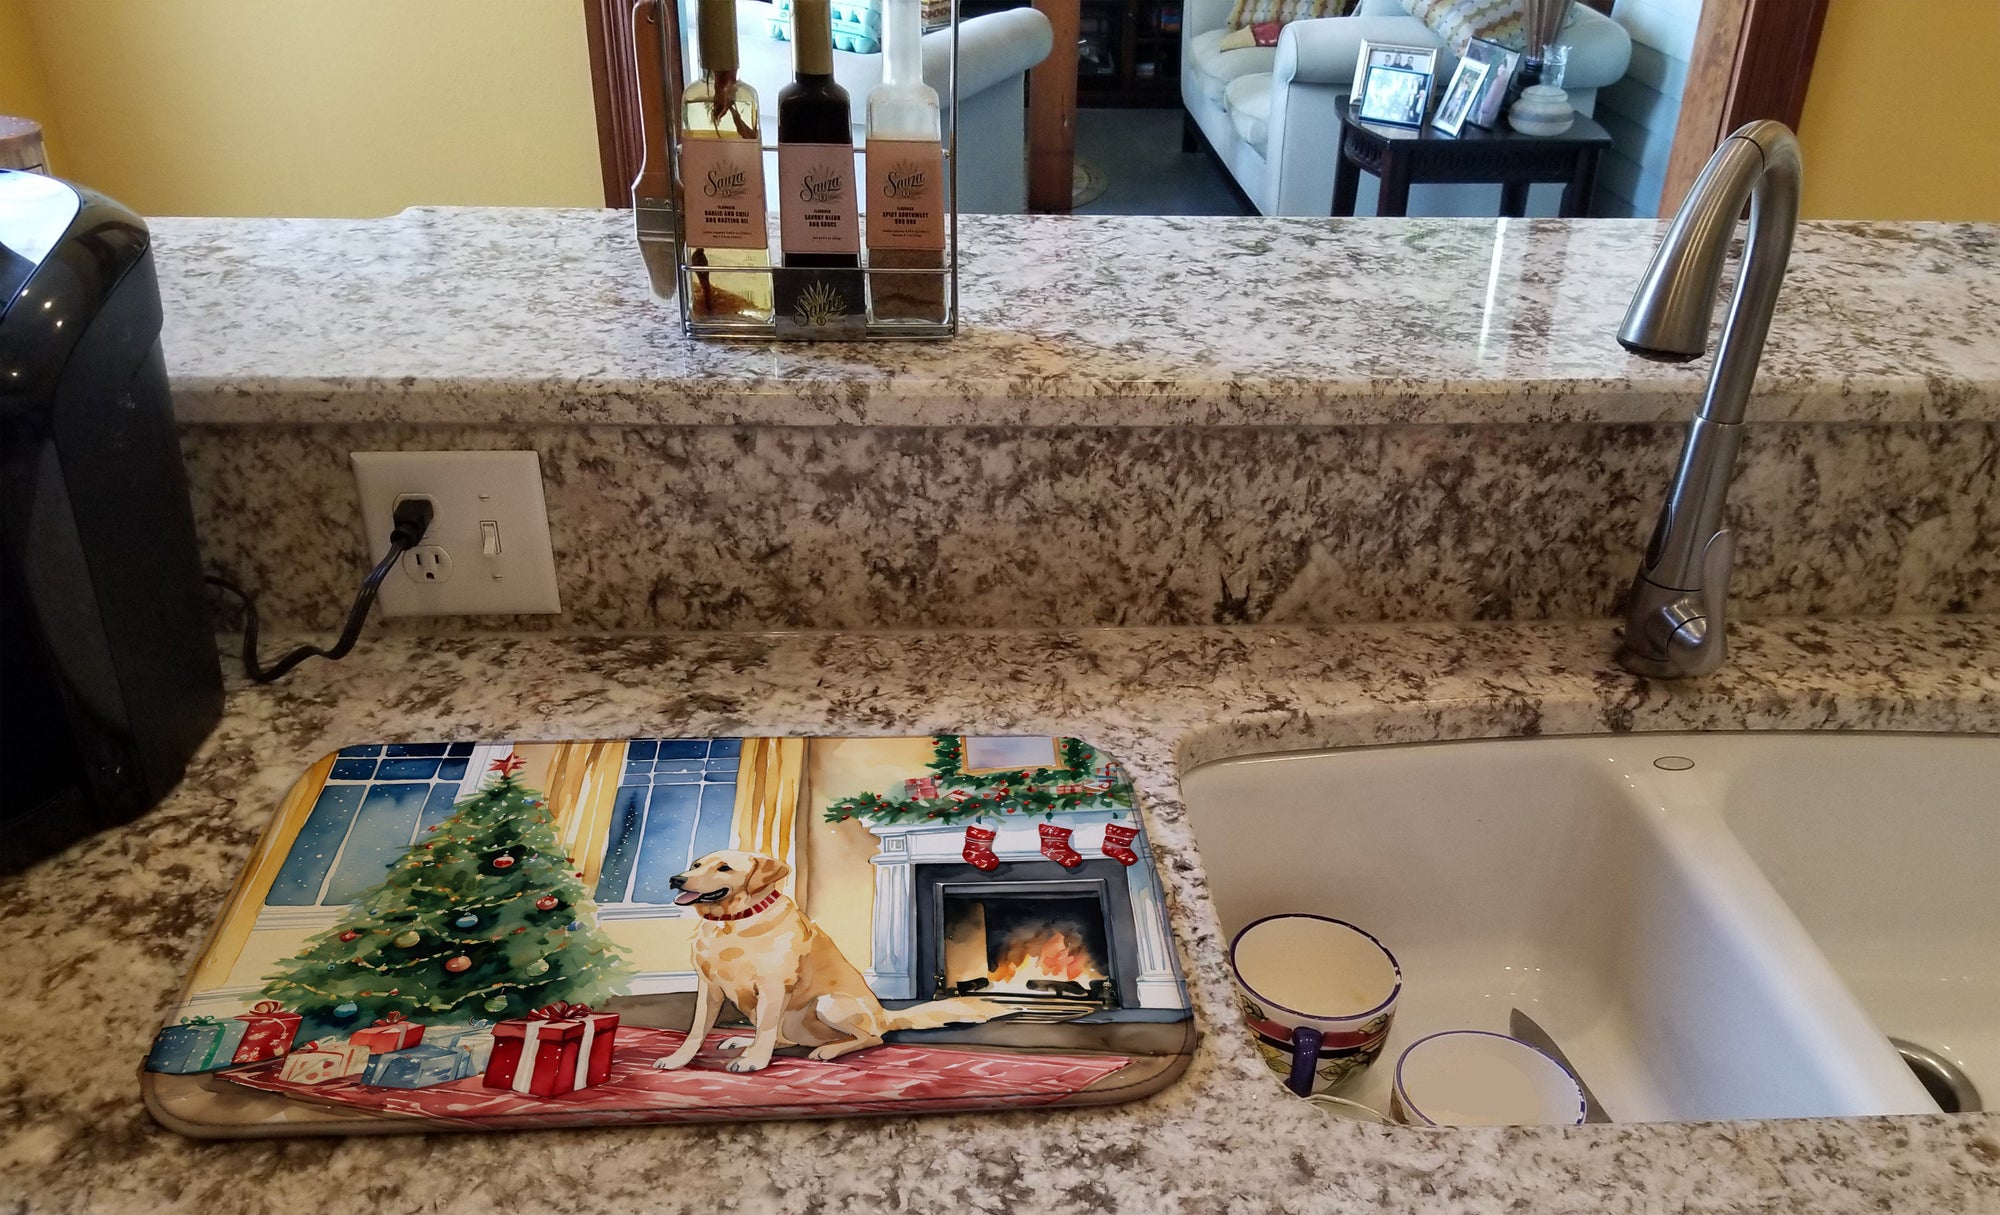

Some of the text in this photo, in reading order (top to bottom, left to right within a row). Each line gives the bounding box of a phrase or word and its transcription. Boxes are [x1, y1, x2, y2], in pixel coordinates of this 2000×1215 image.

[704, 170, 745, 197] Sauza
[800, 175, 841, 202] Sauza
[884, 171, 923, 198] Sauza
[717, 217, 740, 225] BASTING
[898, 211, 929, 219] SOUTHWEST
